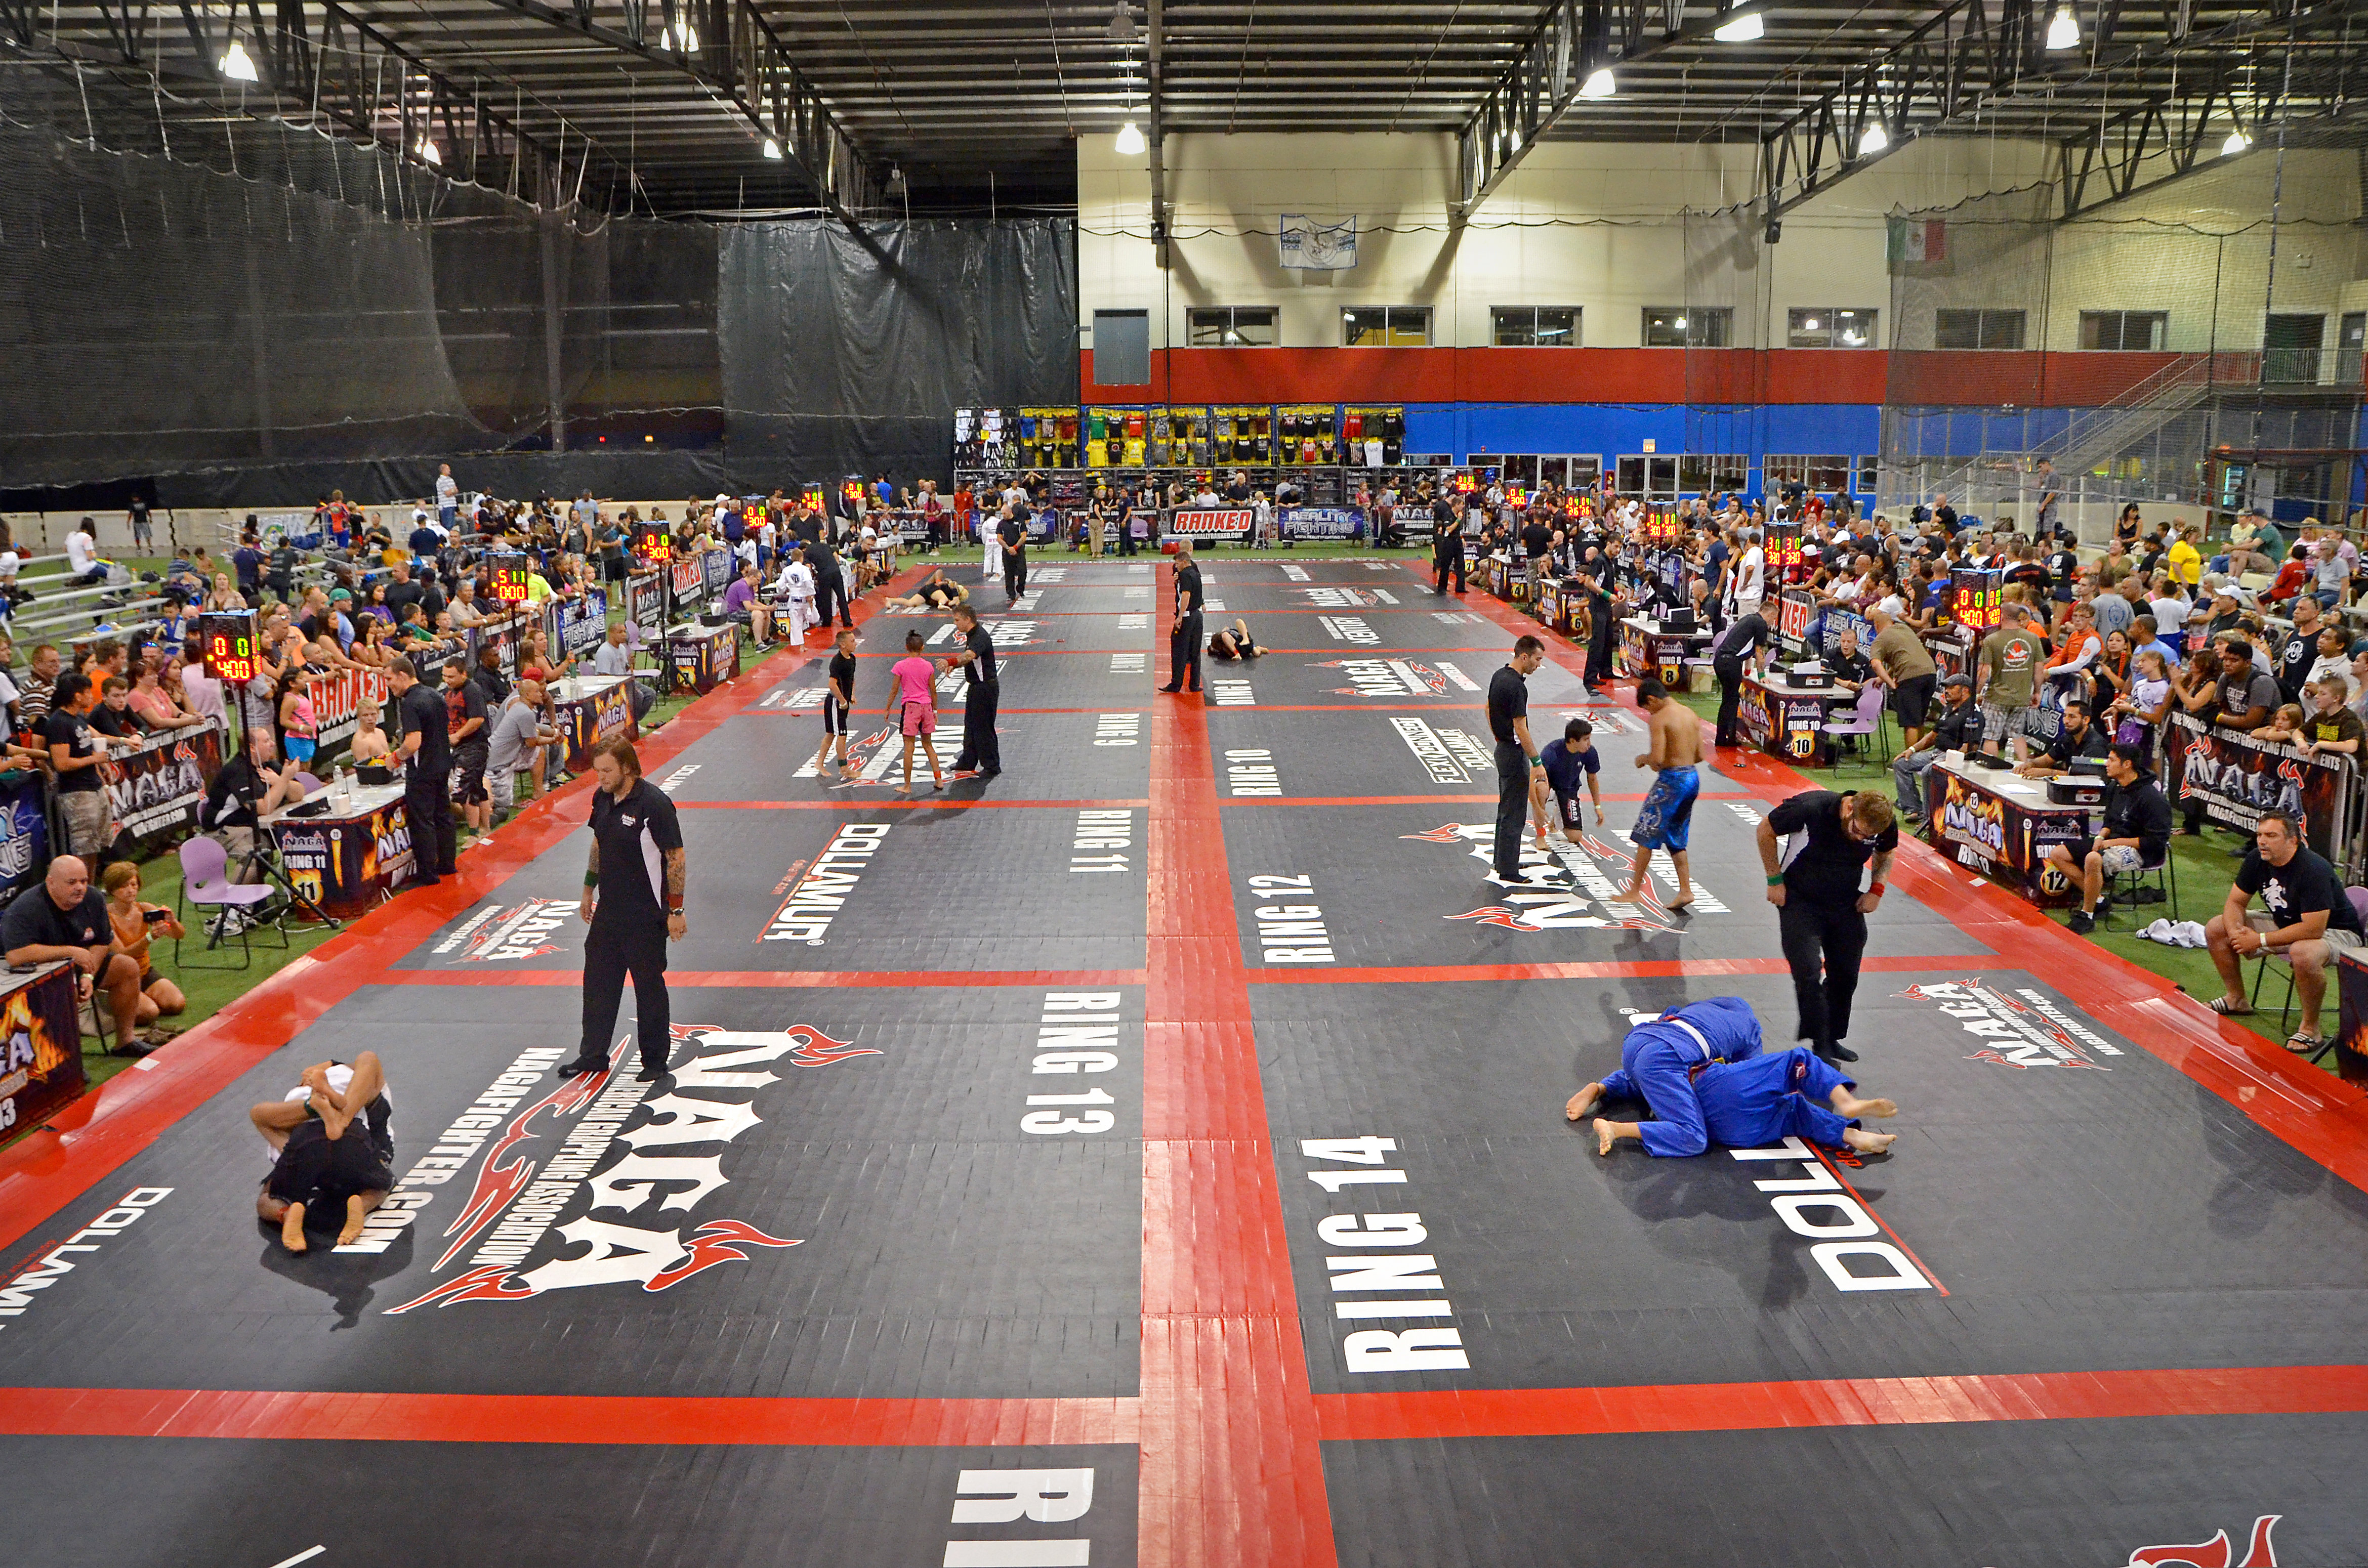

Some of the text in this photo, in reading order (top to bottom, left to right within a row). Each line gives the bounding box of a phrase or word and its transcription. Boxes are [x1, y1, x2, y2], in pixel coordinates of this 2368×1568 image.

[1174, 510, 1253, 533] RANKED
[1284, 522, 1356, 535] FIGHTING
[1288, 511, 1353, 523] REALITY
[647, 534, 668, 546] 0 0
[1768, 537, 1780, 551] 3 0
[1787, 537, 1800, 550] 3 0
[498, 569, 508, 583] 5
[1960, 589, 1983, 608] 0 0
[1330, 616, 1381, 644] CENTURY
[1575, 618, 1582, 628] 6
[214, 637, 226, 656] 0
[237, 637, 248, 657] 0
[1110, 654, 1145, 668] RING
[1659, 656, 1682, 664] RING 8
[1339, 659, 1410, 696] NAGA
[1666, 671, 1674, 683] 8
[1215, 686, 1256, 705] RING
[541, 712, 571, 721] NGA
[1096, 713, 1140, 737] RING
[1788, 721, 1820, 731] RING 10
[1395, 718, 1440, 752] CONNECT
[1795, 739, 1811, 753] 10
[1433, 729, 1492, 768] DOLLAMUR
[1225, 749, 1282, 795] RING 10
[2185, 749, 2304, 817] NAGA
[284, 838, 324, 846] NAGA
[1069, 810, 1132, 872] RING 11
[2039, 826, 2080, 834] NAGA
[284, 855, 326, 869] RING 11
[299, 881, 316, 901] 11
[764, 824, 891, 941] DOLLAMUR
[2047, 871, 2066, 891] 12
[488, 900, 581, 960] NAGA
[1249, 874, 1336, 962] RING 12
[1921, 982, 2062, 1067] NAGA
[2015, 989, 2125, 1055] NAGAFIGHTER.COM
[1020, 992, 1120, 1135] RING 13
[0, 1097, 16, 1130] 3
[331, 1047, 566, 1253] NAGAFIGHTER.COM
[518, 1031, 801, 1291] NAGA
[547, 1122, 624, 1177] GRAPPLING
[470, 1178, 580, 1265] ASSOCIATION
[1729, 1136, 1933, 1291] DOLL
[0, 1187, 175, 1332] DOLLAM
[1301, 1136, 1470, 1372] RING 14
[943, 1468, 1095, 1568] RI
